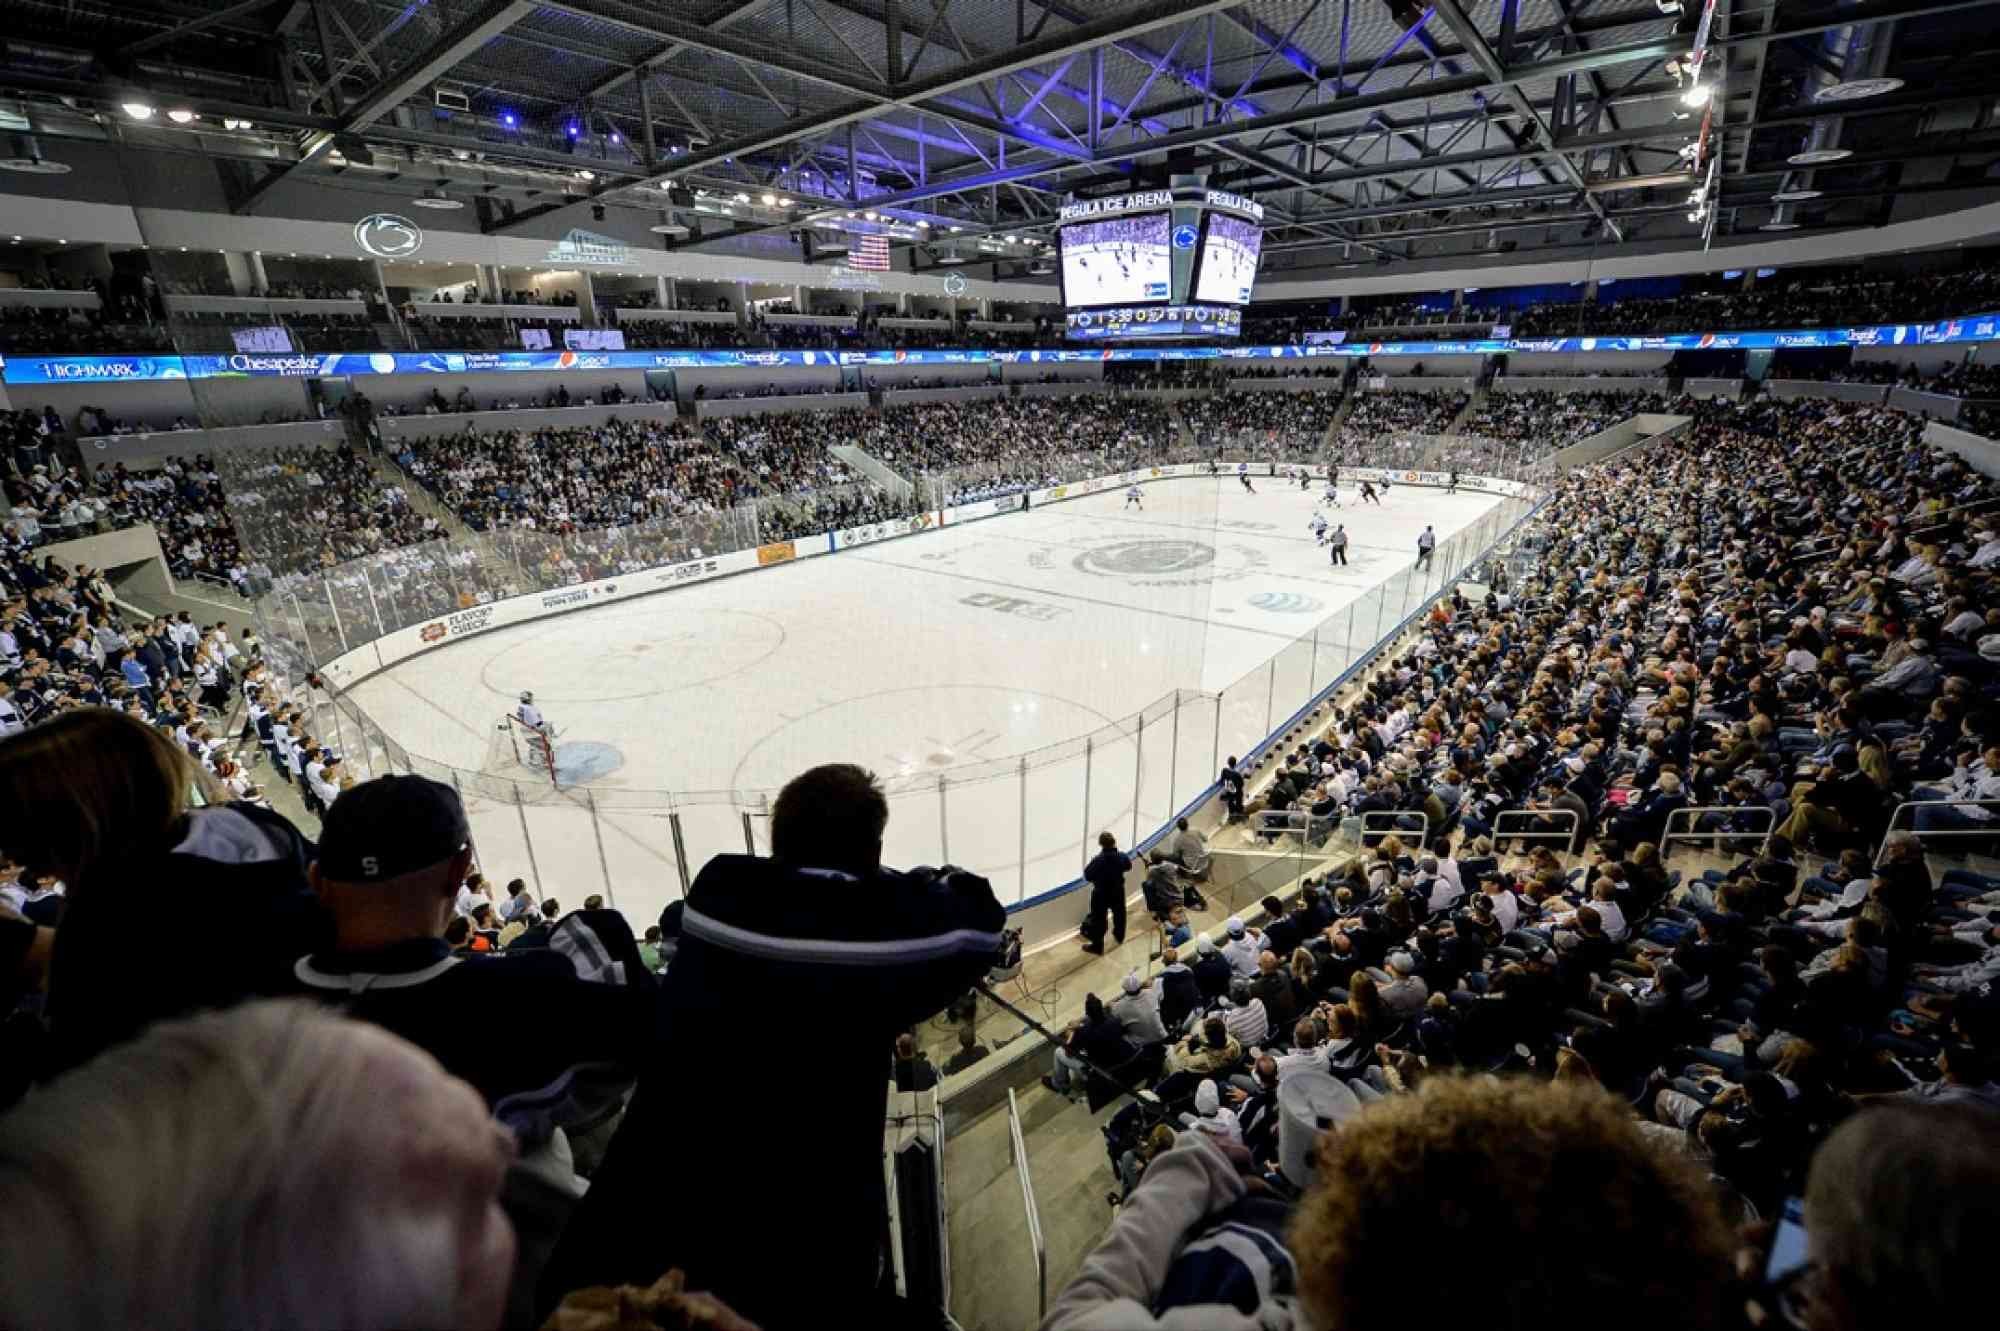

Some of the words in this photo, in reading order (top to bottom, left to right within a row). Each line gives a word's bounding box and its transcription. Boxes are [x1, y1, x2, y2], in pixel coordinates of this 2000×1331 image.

[1060, 201, 1100, 220] PEGULA
[1104, 197, 1124, 213] ICE
[1127, 191, 1174, 209] ARENA
[230, 354, 320, 370] Chesapeake
[362, 856, 379, 875] S
